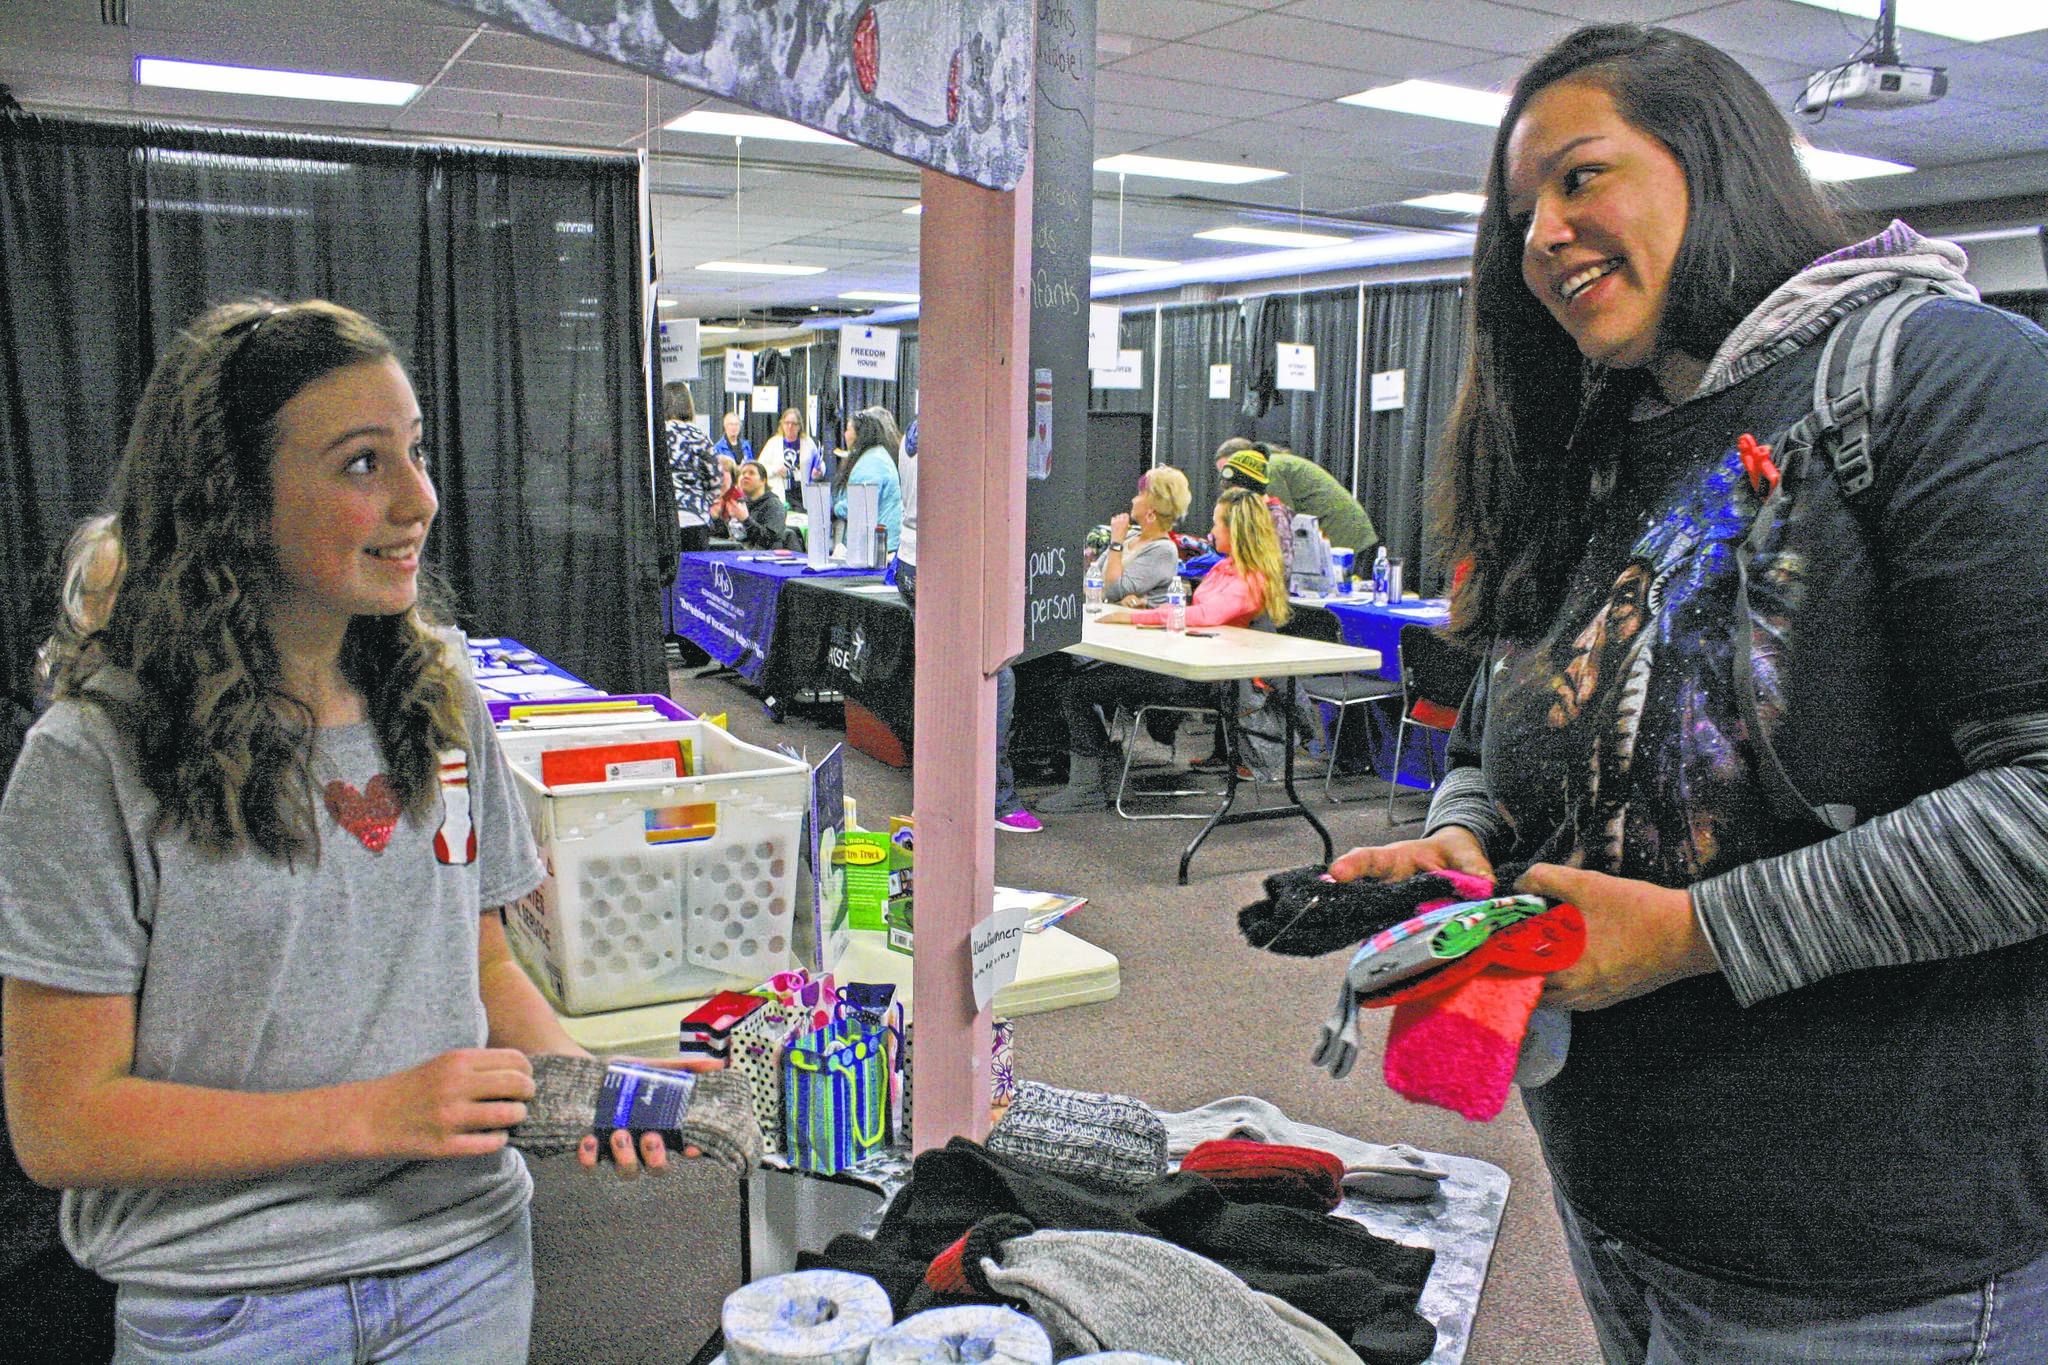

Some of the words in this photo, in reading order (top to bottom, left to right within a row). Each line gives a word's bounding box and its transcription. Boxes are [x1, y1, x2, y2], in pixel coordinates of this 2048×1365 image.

[850, 347, 886, 359] FREEDOM
[857, 359, 878, 368] HOUSE
[1029, 546, 1066, 595] pairs
[1031, 593, 1077, 641] person
